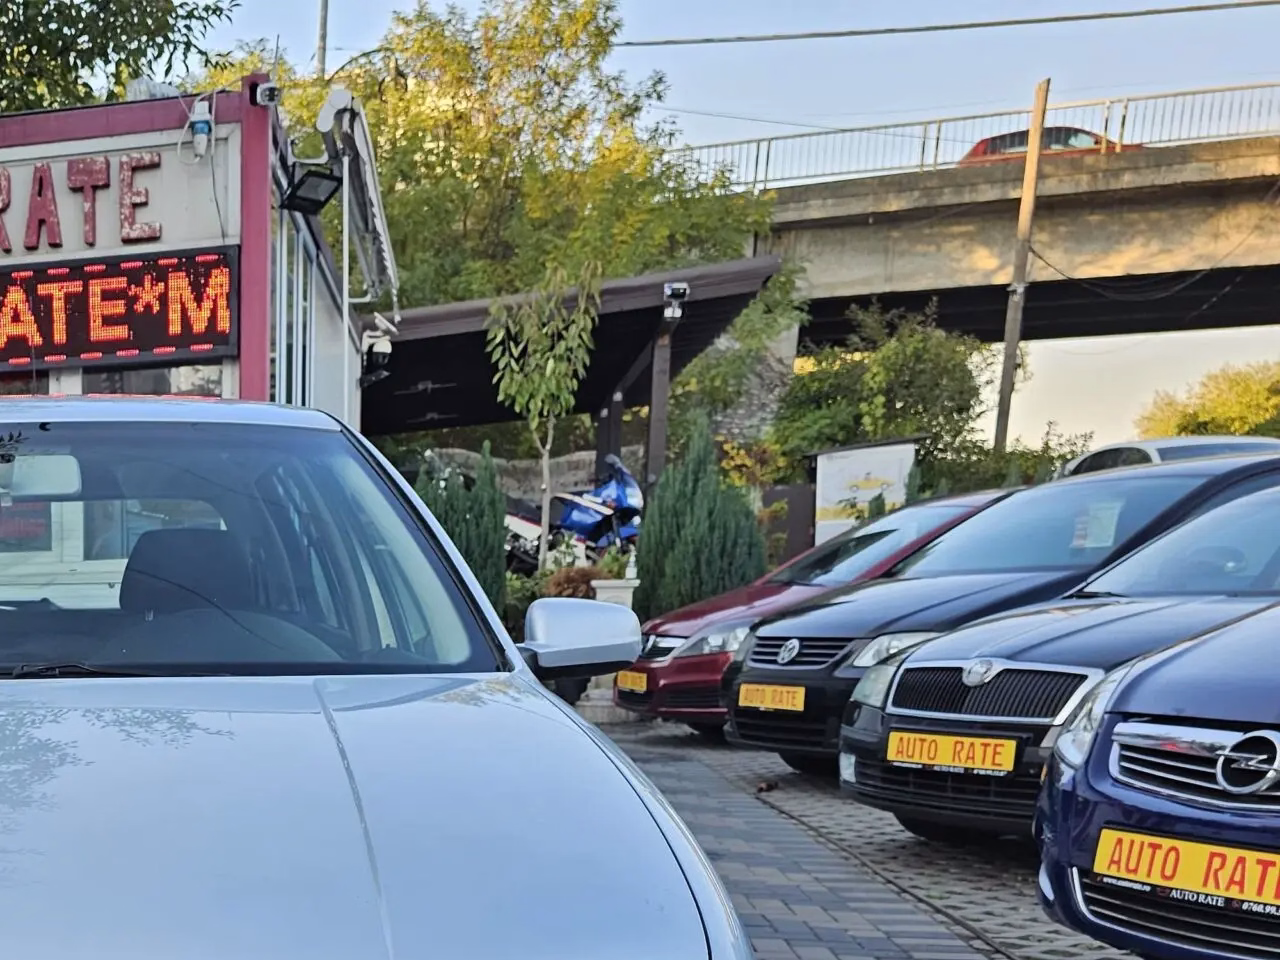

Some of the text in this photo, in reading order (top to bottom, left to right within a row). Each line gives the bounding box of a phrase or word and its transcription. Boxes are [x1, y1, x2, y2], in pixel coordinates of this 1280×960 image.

[770, 688, 799, 708] RATE
[895, 736, 1005, 767] AUTO RATE
[1107, 836, 1180, 882] AUTO
[1169, 888, 1197, 902] AUTO
[1197, 894, 1225, 907] RATE
